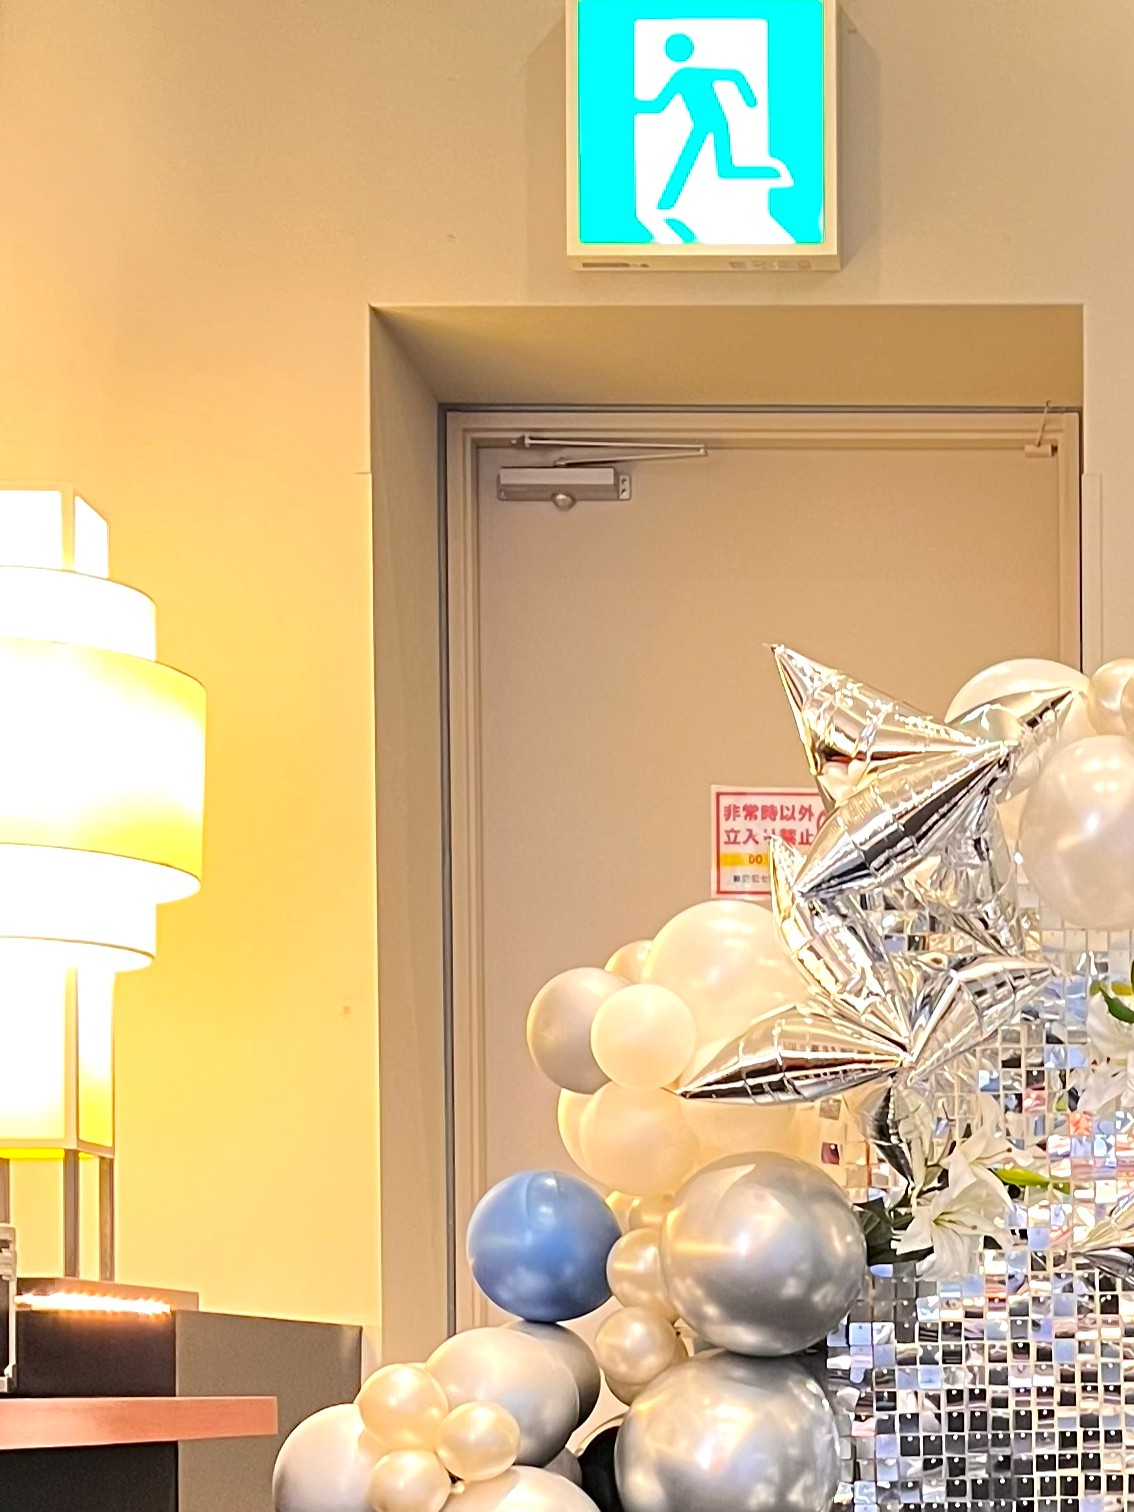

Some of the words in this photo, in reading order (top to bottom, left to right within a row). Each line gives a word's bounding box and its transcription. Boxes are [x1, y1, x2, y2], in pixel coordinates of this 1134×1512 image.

[724, 803, 815, 822] 非常時以外
